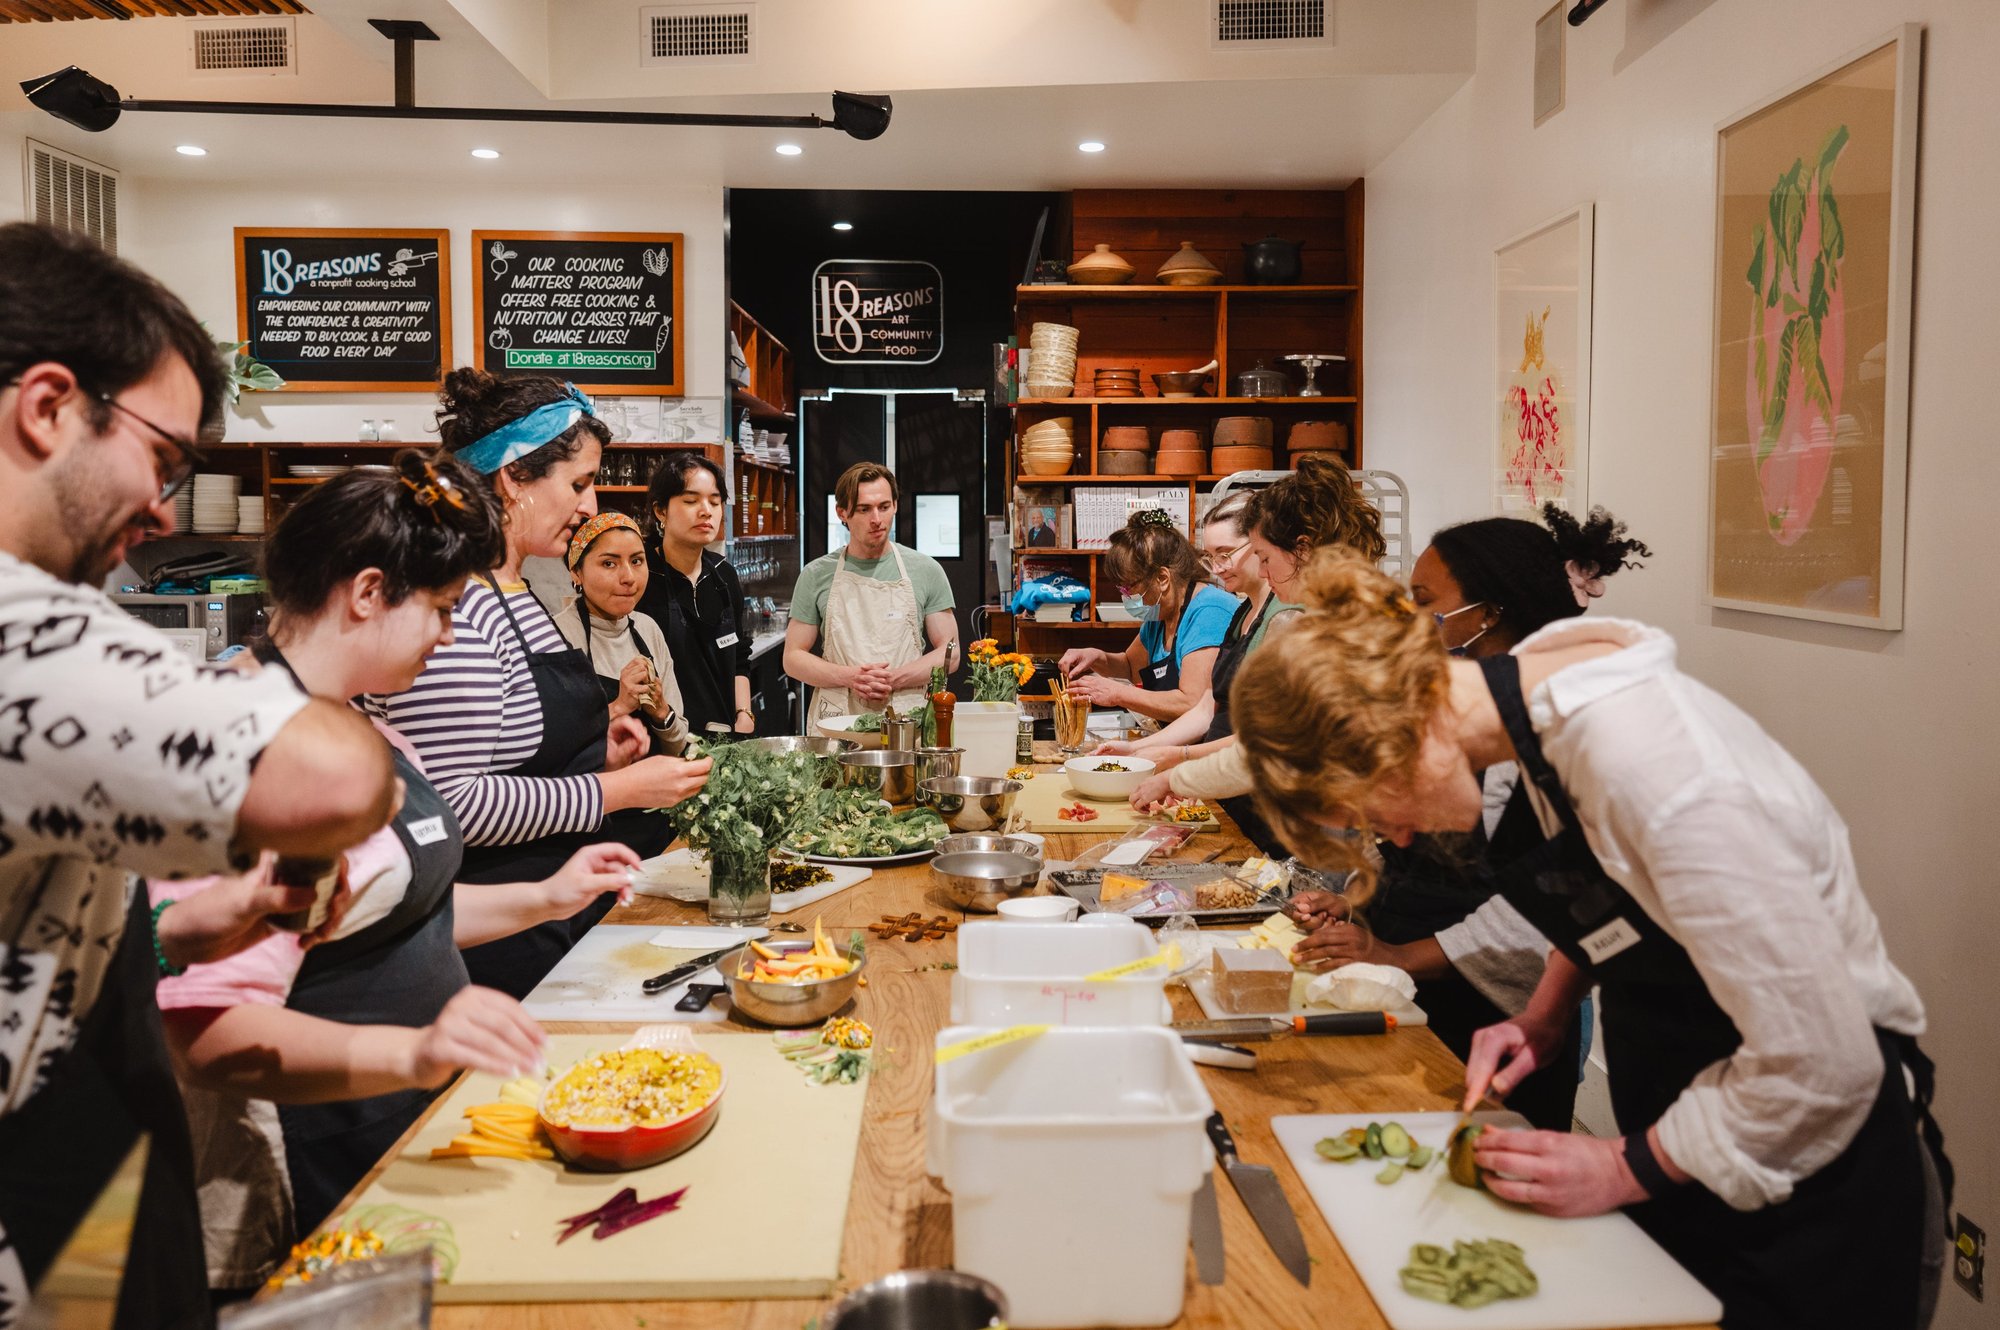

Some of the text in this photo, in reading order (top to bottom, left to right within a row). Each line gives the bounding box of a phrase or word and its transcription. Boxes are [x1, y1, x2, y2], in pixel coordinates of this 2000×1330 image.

[262, 248, 381, 294] 18 REASONS
[528, 257, 625, 273] OUR COOKING
[310, 277, 416, 290] a nonprofit cooking school
[511, 275, 644, 290] MATTERS PROGRAM
[257, 300, 431, 312] EMPOWERING OUR COMMUNITY WITH
[500, 294, 656, 308] OFFERS FREE COOKING &
[265, 315, 423, 327] THE CONFIDENCE & CREATIVITY
[493, 311, 661, 326] NUTRITION CLASSES THAT
[818, 276, 934, 354] 18 REASONS
[891, 315, 910, 324] ART
[260, 331, 432, 342] NEEDED TO BUY, COOK, & EAT GOOD
[533, 330, 630, 345] CHANGE LIVES!
[870, 330, 933, 340] COMMUNITY
[300, 346, 397, 357] FOOD EVERY DAY
[885, 346, 917, 355] FOOD
[509, 352, 651, 369] Donate at 18reasons.org
